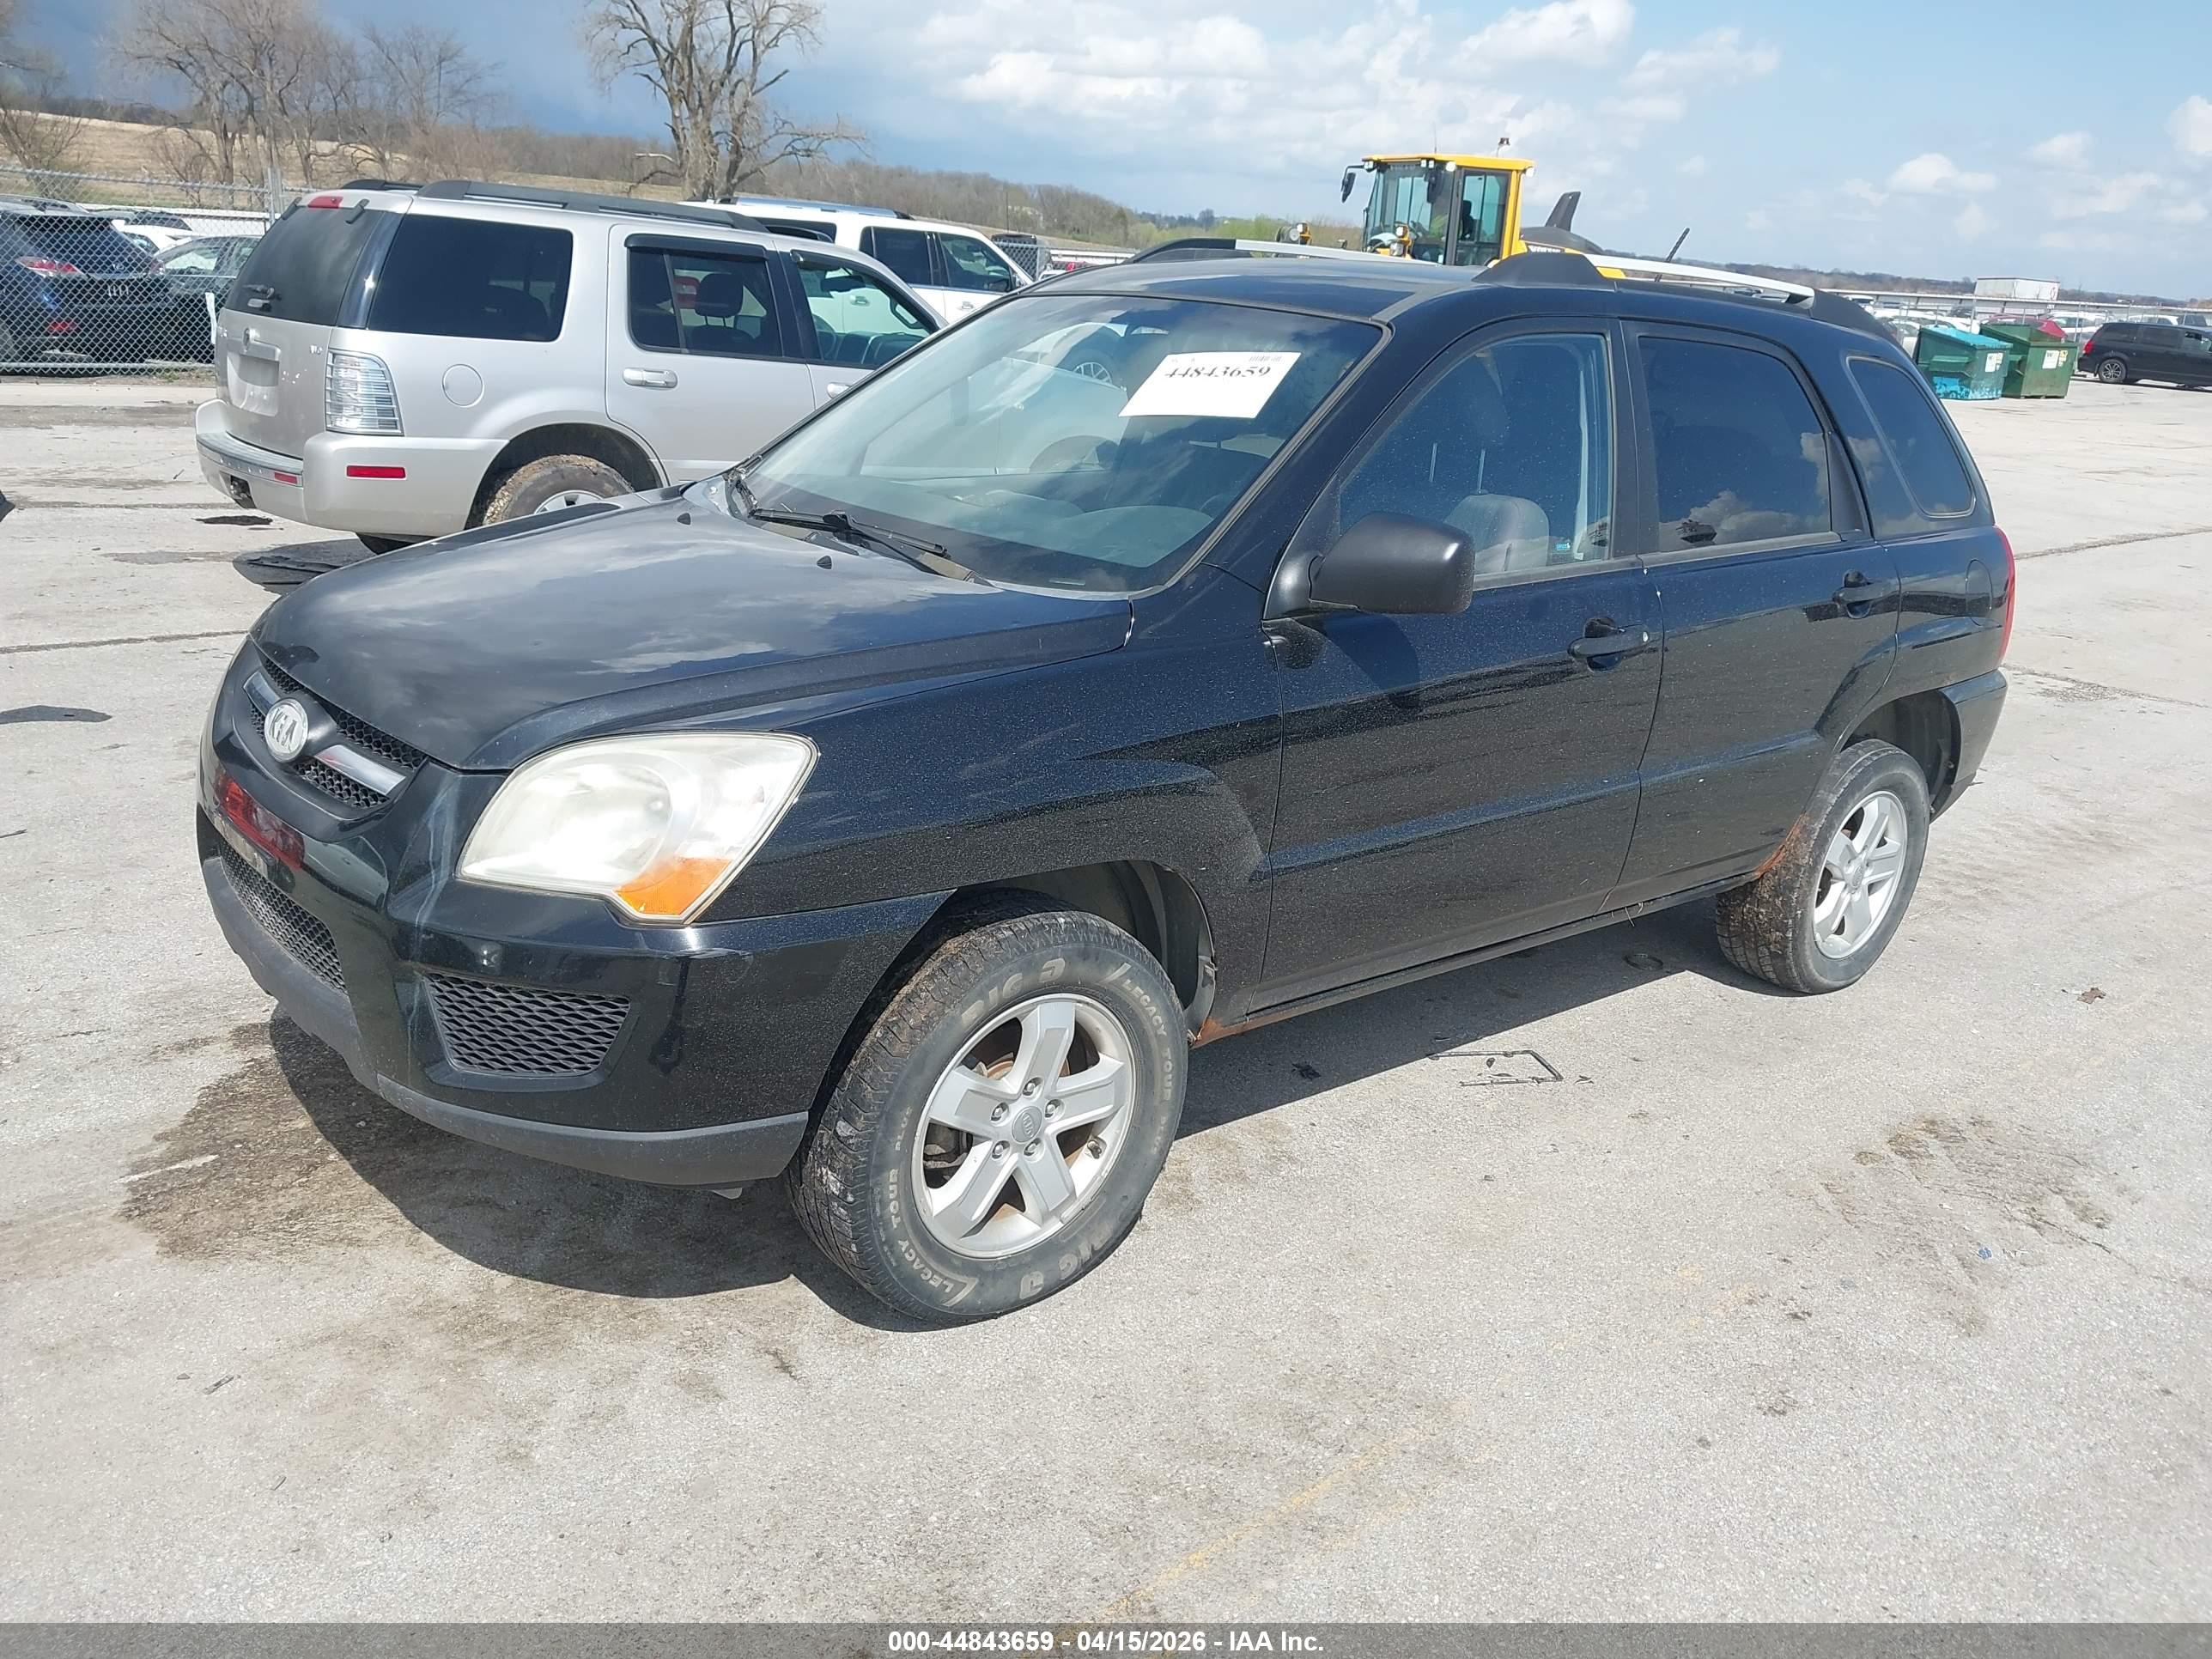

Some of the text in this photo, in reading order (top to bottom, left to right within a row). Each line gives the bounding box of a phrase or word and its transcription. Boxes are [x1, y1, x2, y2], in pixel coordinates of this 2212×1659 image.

[1164, 366, 1271, 378] 44843659
[1121, 979, 1168, 1037] LEGACY
[1162, 1047, 1174, 1102] TOUR
[888, 1168, 902, 1229] TOUR
[897, 1238, 955, 1293] LEGACY
